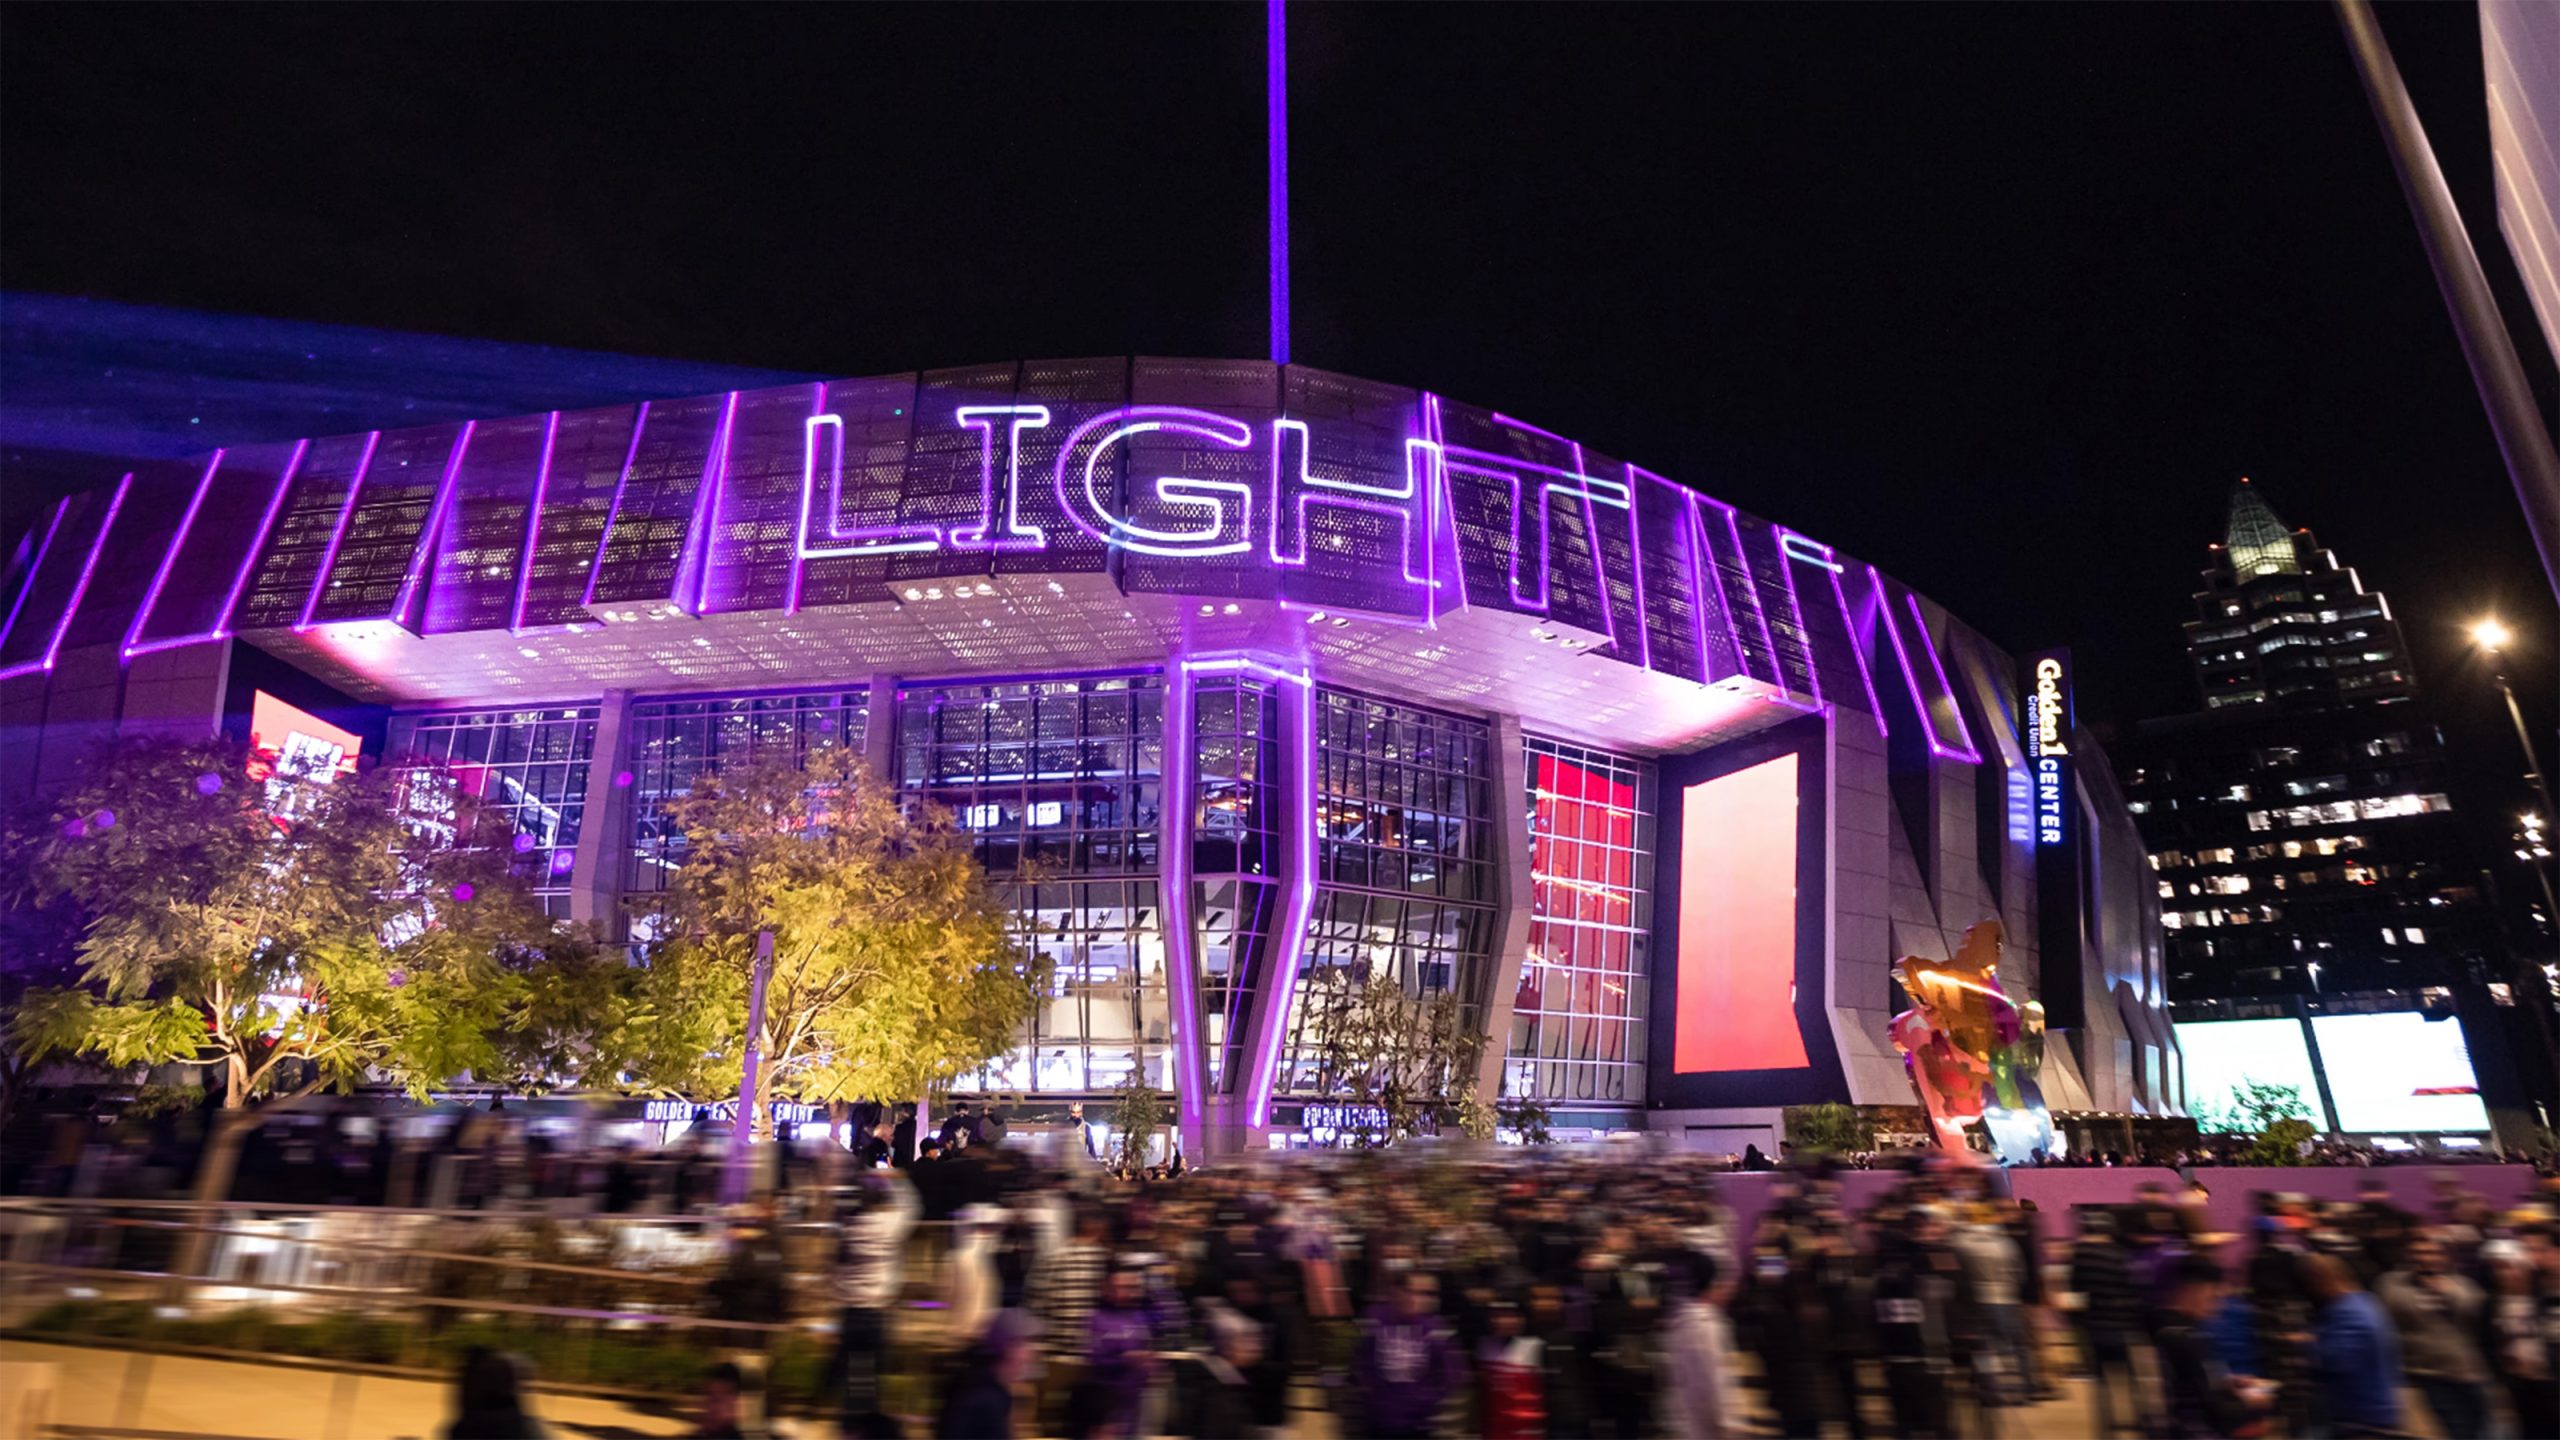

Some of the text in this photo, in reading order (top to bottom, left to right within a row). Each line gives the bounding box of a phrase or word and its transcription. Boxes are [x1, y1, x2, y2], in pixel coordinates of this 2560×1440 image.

[798, 404, 1630, 610] LIGHT
[2028, 694, 2040, 757] Credit Union
[2039, 759, 2061, 843] CENTER
[647, 1101, 692, 1121] GOLDEN
